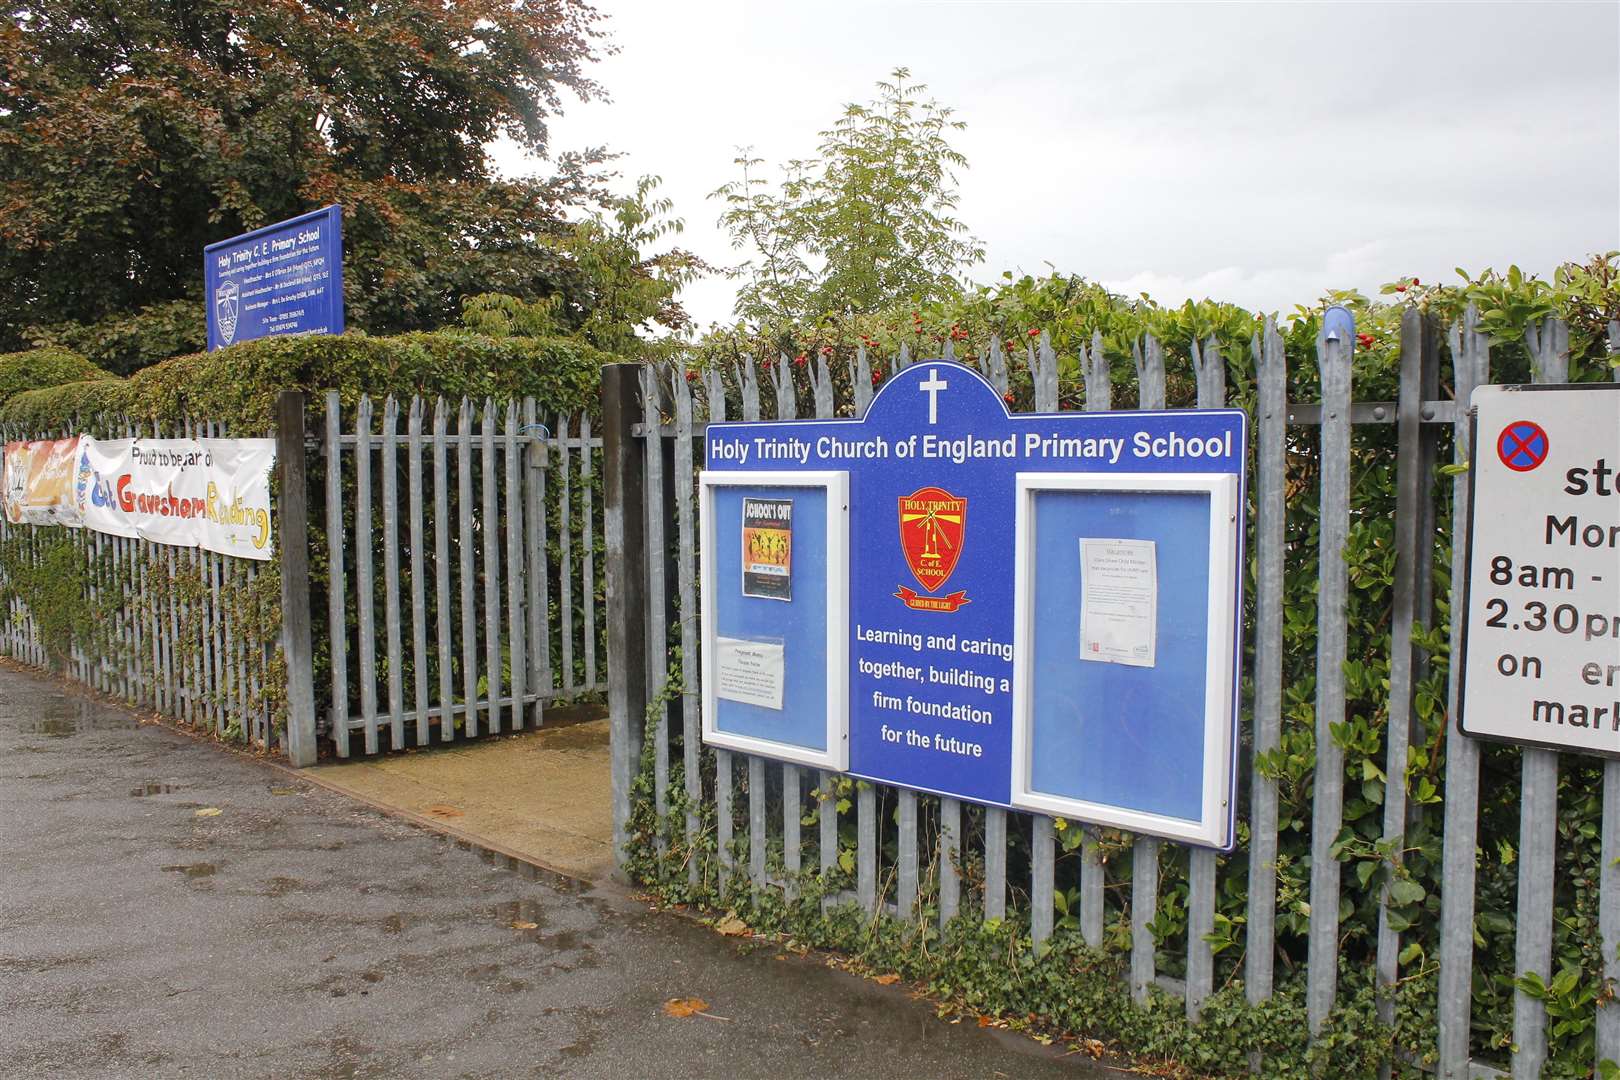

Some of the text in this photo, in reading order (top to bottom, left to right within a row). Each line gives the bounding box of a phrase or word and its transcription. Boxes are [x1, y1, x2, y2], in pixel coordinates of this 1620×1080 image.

[218, 227, 319, 269] Holy Trinity C. E. Primary School
[132, 446, 156, 466] Proud
[158, 449, 169, 466] to
[711, 430, 1231, 464] Holy Trinity Church of England Primary School
[117, 474, 207, 521] Gravesham
[777, 505, 791, 521] OUT
[905, 500, 961, 512] HOLY TRINITY
[917, 567, 945, 577] SCHOOL
[1490, 555, 1574, 590] 8am
[1486, 598, 1620, 641] 2.30p
[856, 624, 1013, 662] Learning and caring
[858, 657, 1010, 695] together, building a
[1497, 653, 1542, 679] on
[873, 691, 992, 725] firm foundation
[881, 724, 983, 757] for the future
